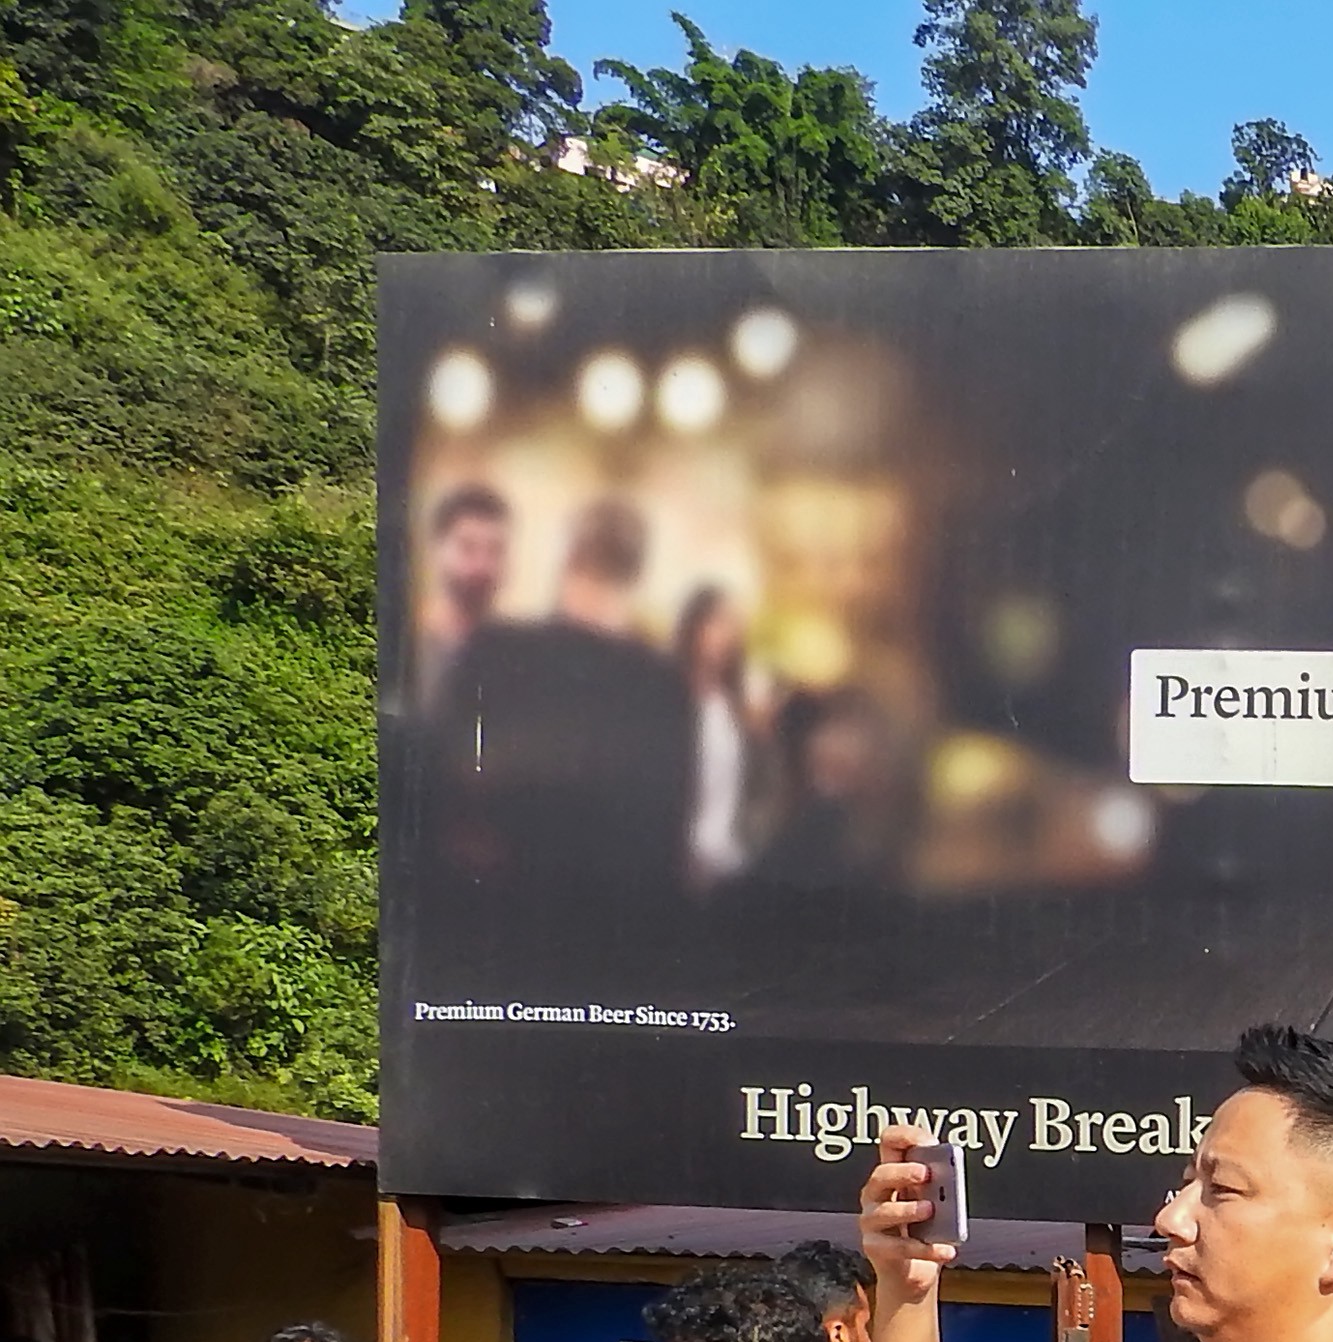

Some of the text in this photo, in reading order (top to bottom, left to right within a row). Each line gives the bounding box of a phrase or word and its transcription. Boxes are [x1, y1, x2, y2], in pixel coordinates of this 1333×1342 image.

[415, 1000, 736, 1032] Premium German Beer Since 1753.
[740, 1083, 1212, 1168] Highway Break
